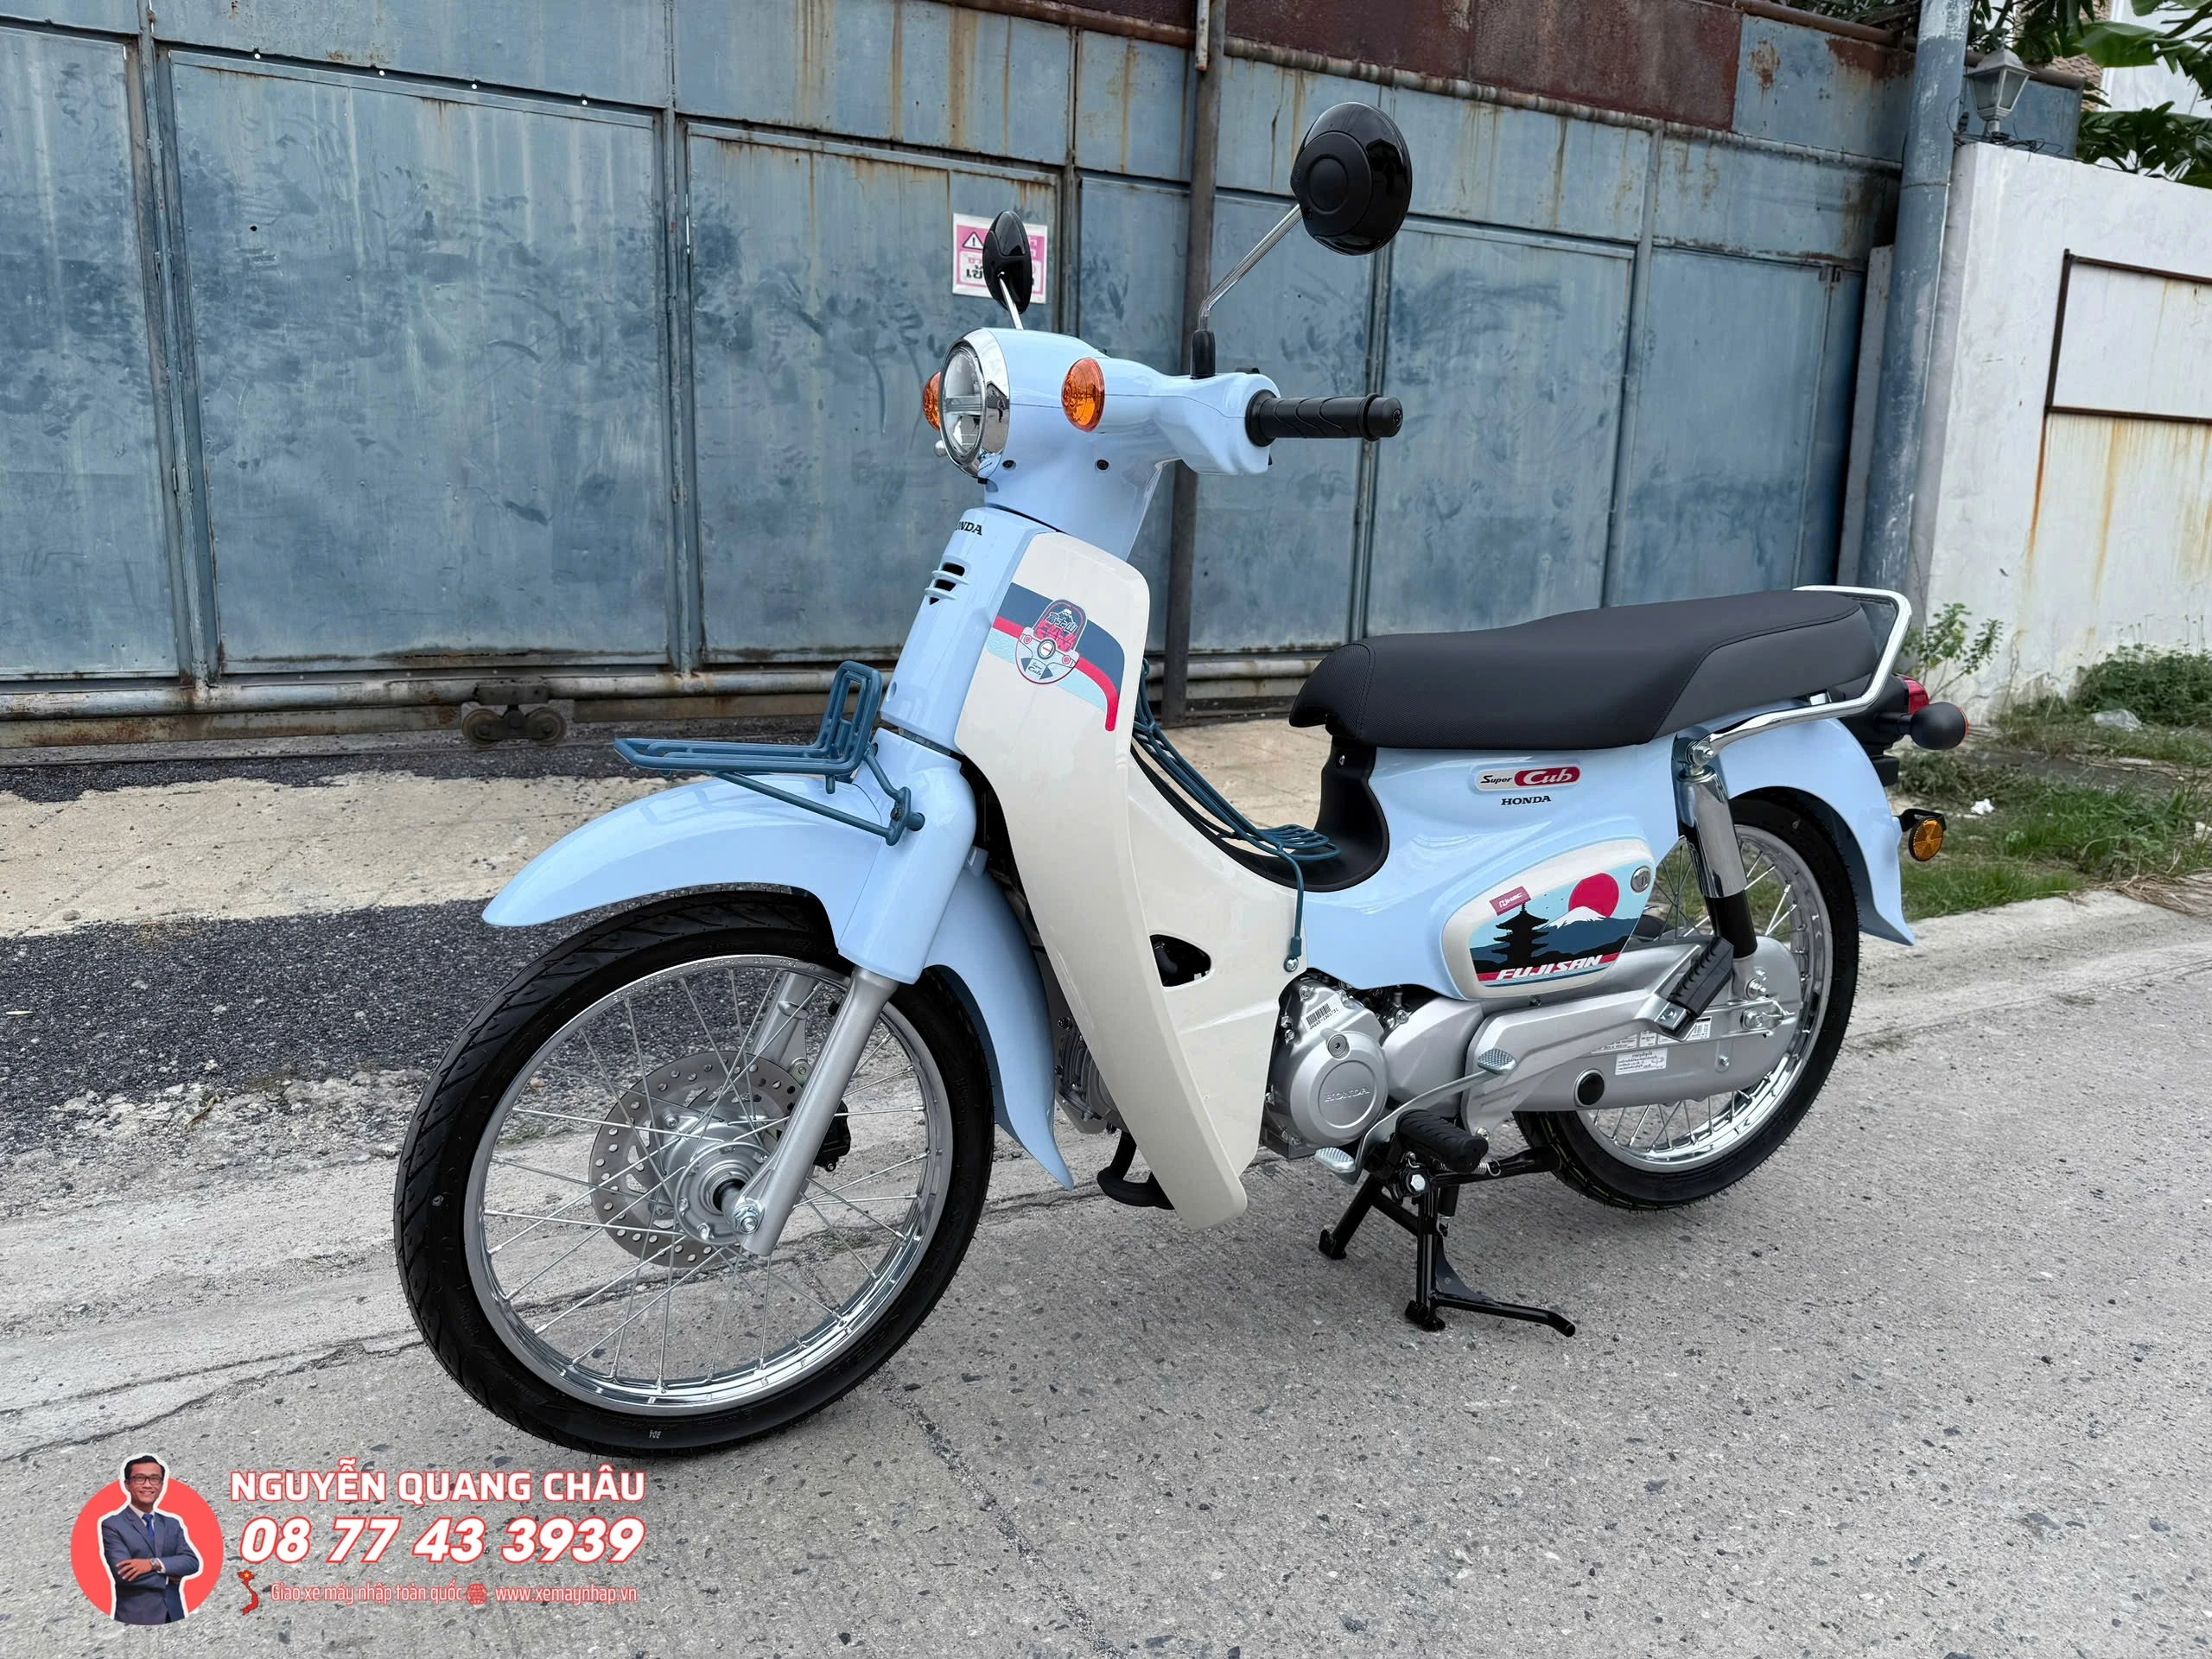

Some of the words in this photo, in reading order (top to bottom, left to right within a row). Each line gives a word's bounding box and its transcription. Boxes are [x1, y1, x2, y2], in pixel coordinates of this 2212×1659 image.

[1480, 774, 1513, 785] Super
[1522, 769, 1573, 785] Cub
[1501, 795, 1552, 806] HONDA
[1496, 954, 1604, 981] FUJISAN
[1324, 1088, 1370, 1103] HONDA
